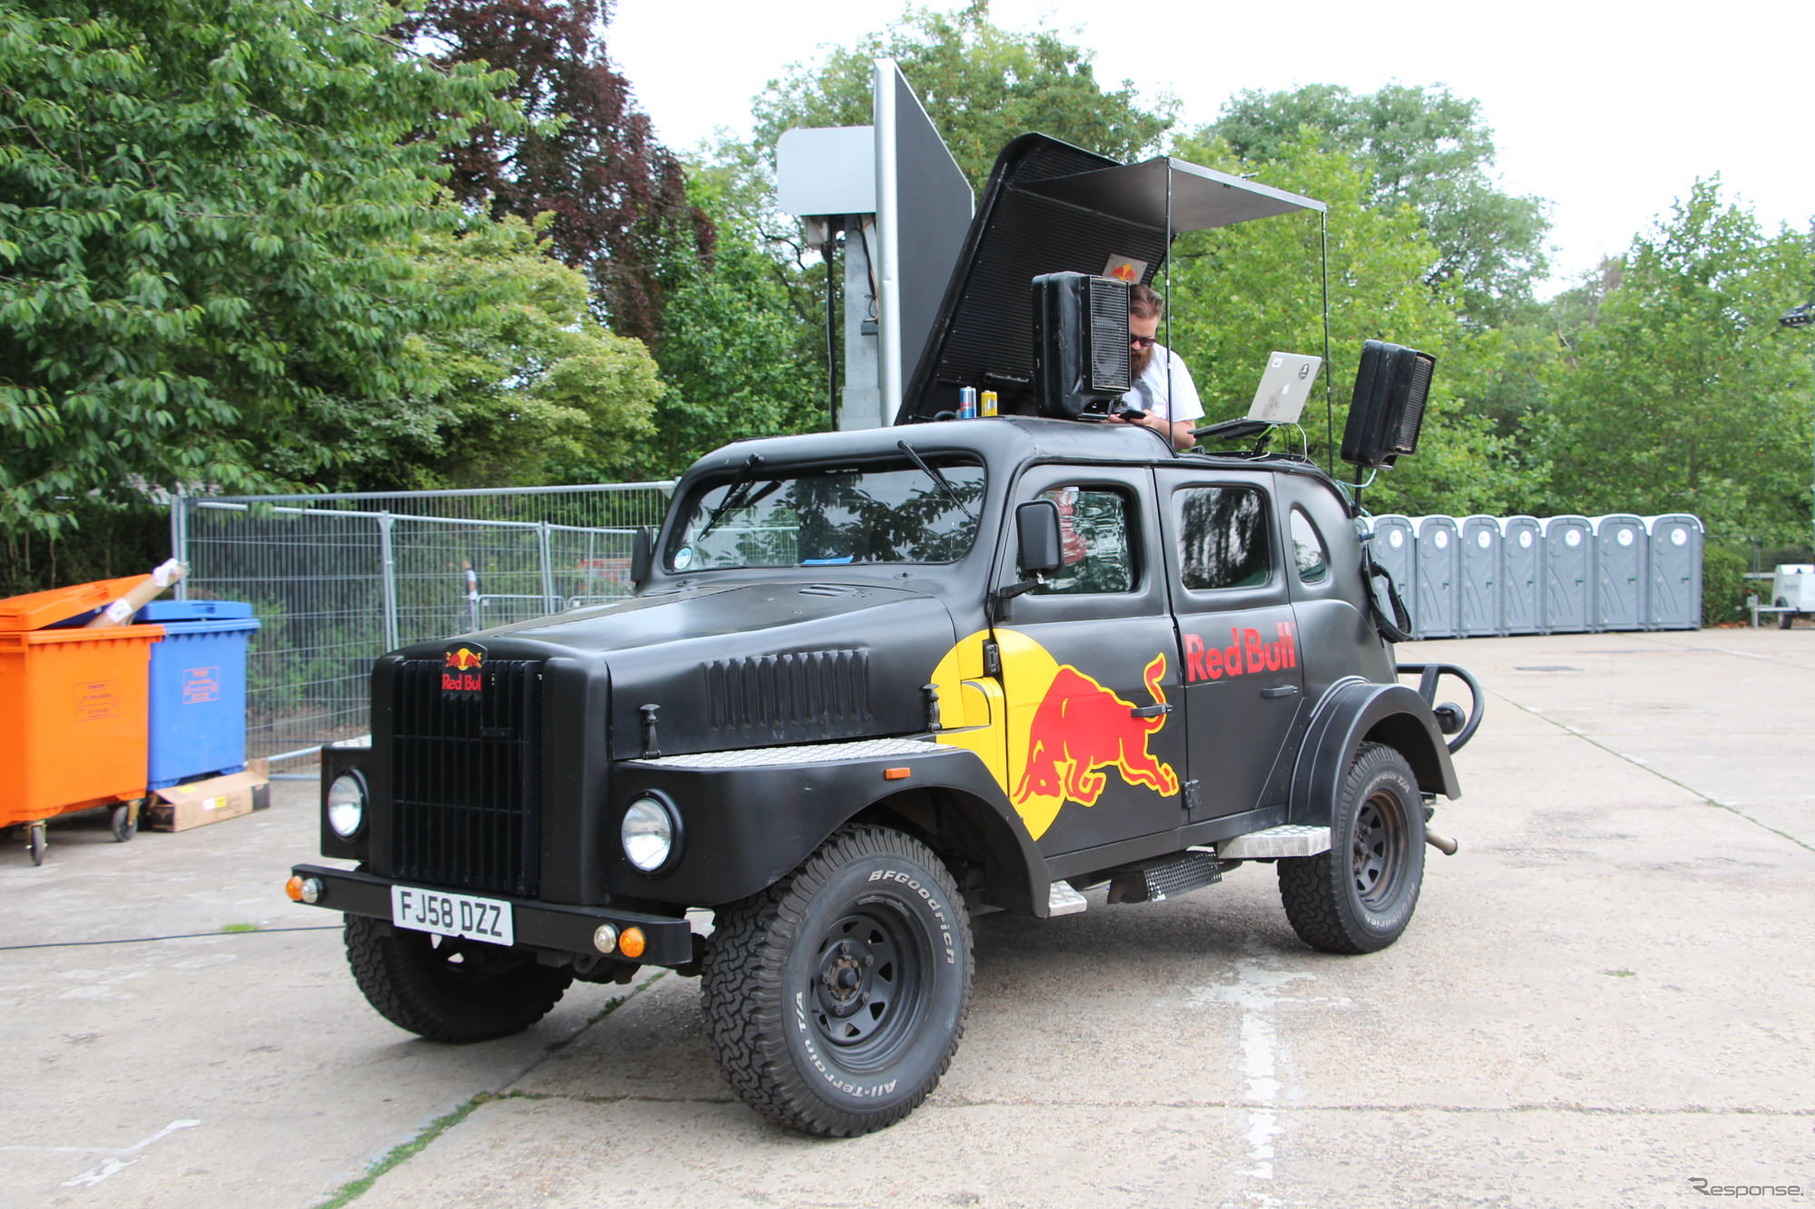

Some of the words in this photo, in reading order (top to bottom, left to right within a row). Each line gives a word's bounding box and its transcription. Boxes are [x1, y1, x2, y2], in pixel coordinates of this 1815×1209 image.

[1184, 627, 1243, 682] Red
[1243, 622, 1296, 673] Bull
[442, 673, 462, 690] Red
[464, 674, 482, 691] Bul
[401, 891, 453, 928] FJ58
[460, 901, 502, 937] DZZ
[868, 869, 955, 964] BFGoodrich
[795, 991, 806, 1033] T/A
[804, 1039, 898, 1097] All-Terrain
